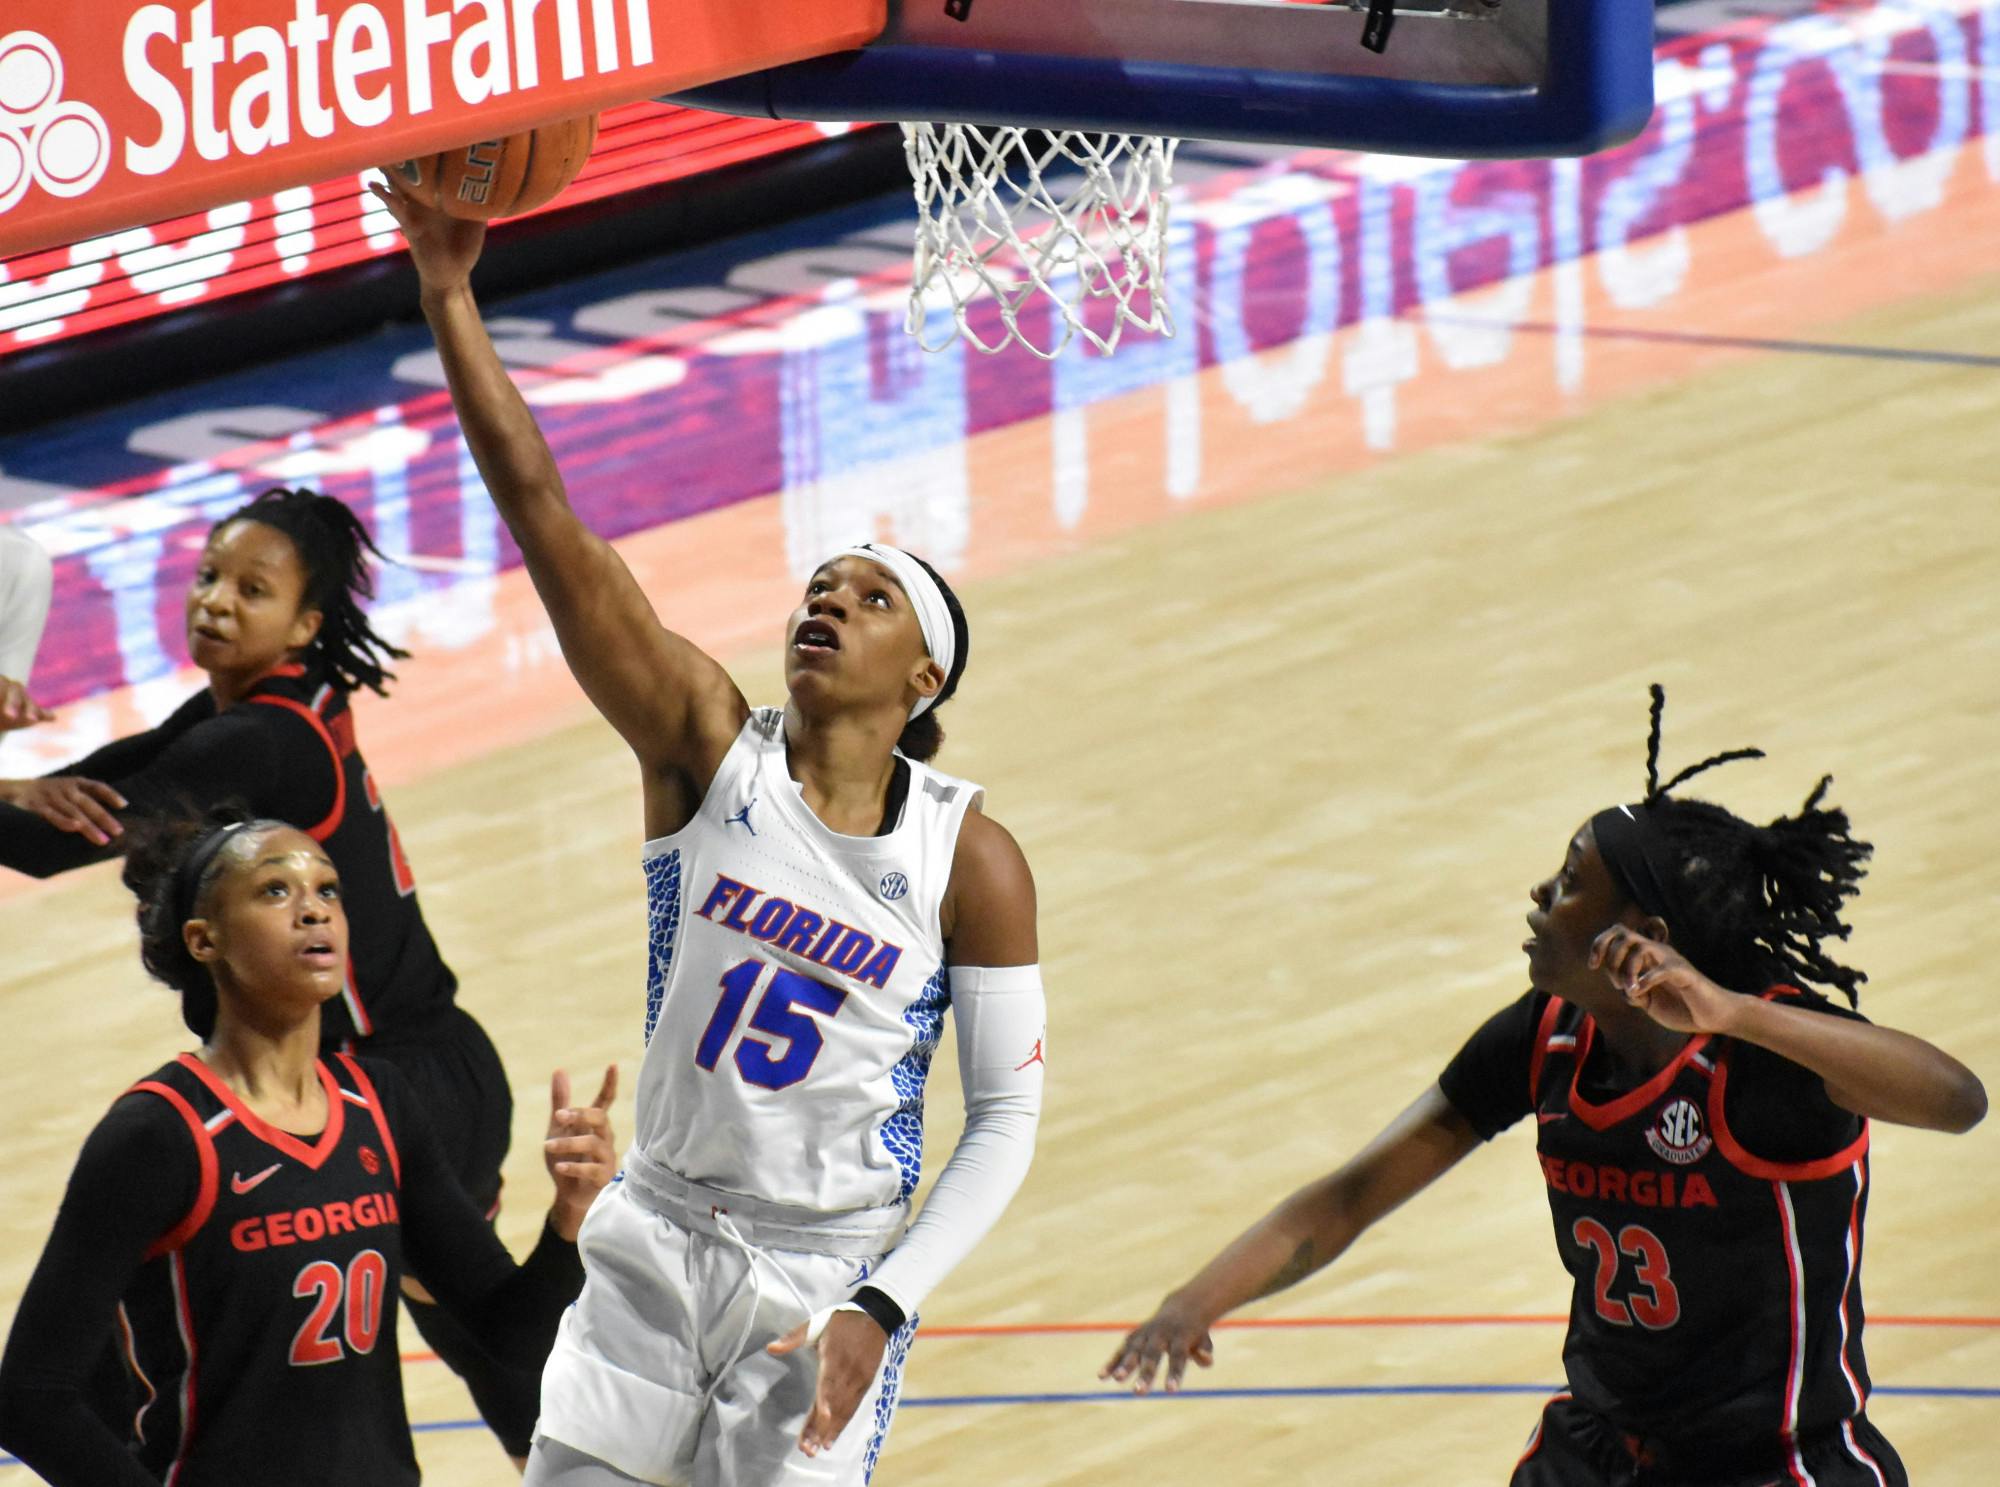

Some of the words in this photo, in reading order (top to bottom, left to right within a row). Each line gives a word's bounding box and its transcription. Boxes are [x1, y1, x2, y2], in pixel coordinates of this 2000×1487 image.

[694, 872, 904, 990] FLORIDA
[695, 956, 849, 1092] 15
[1538, 1152, 1718, 1209] EORGIA
[1660, 1099, 1701, 1147] SEC
[288, 1248, 388, 1367] 20
[1572, 1216, 1680, 1331] 23
